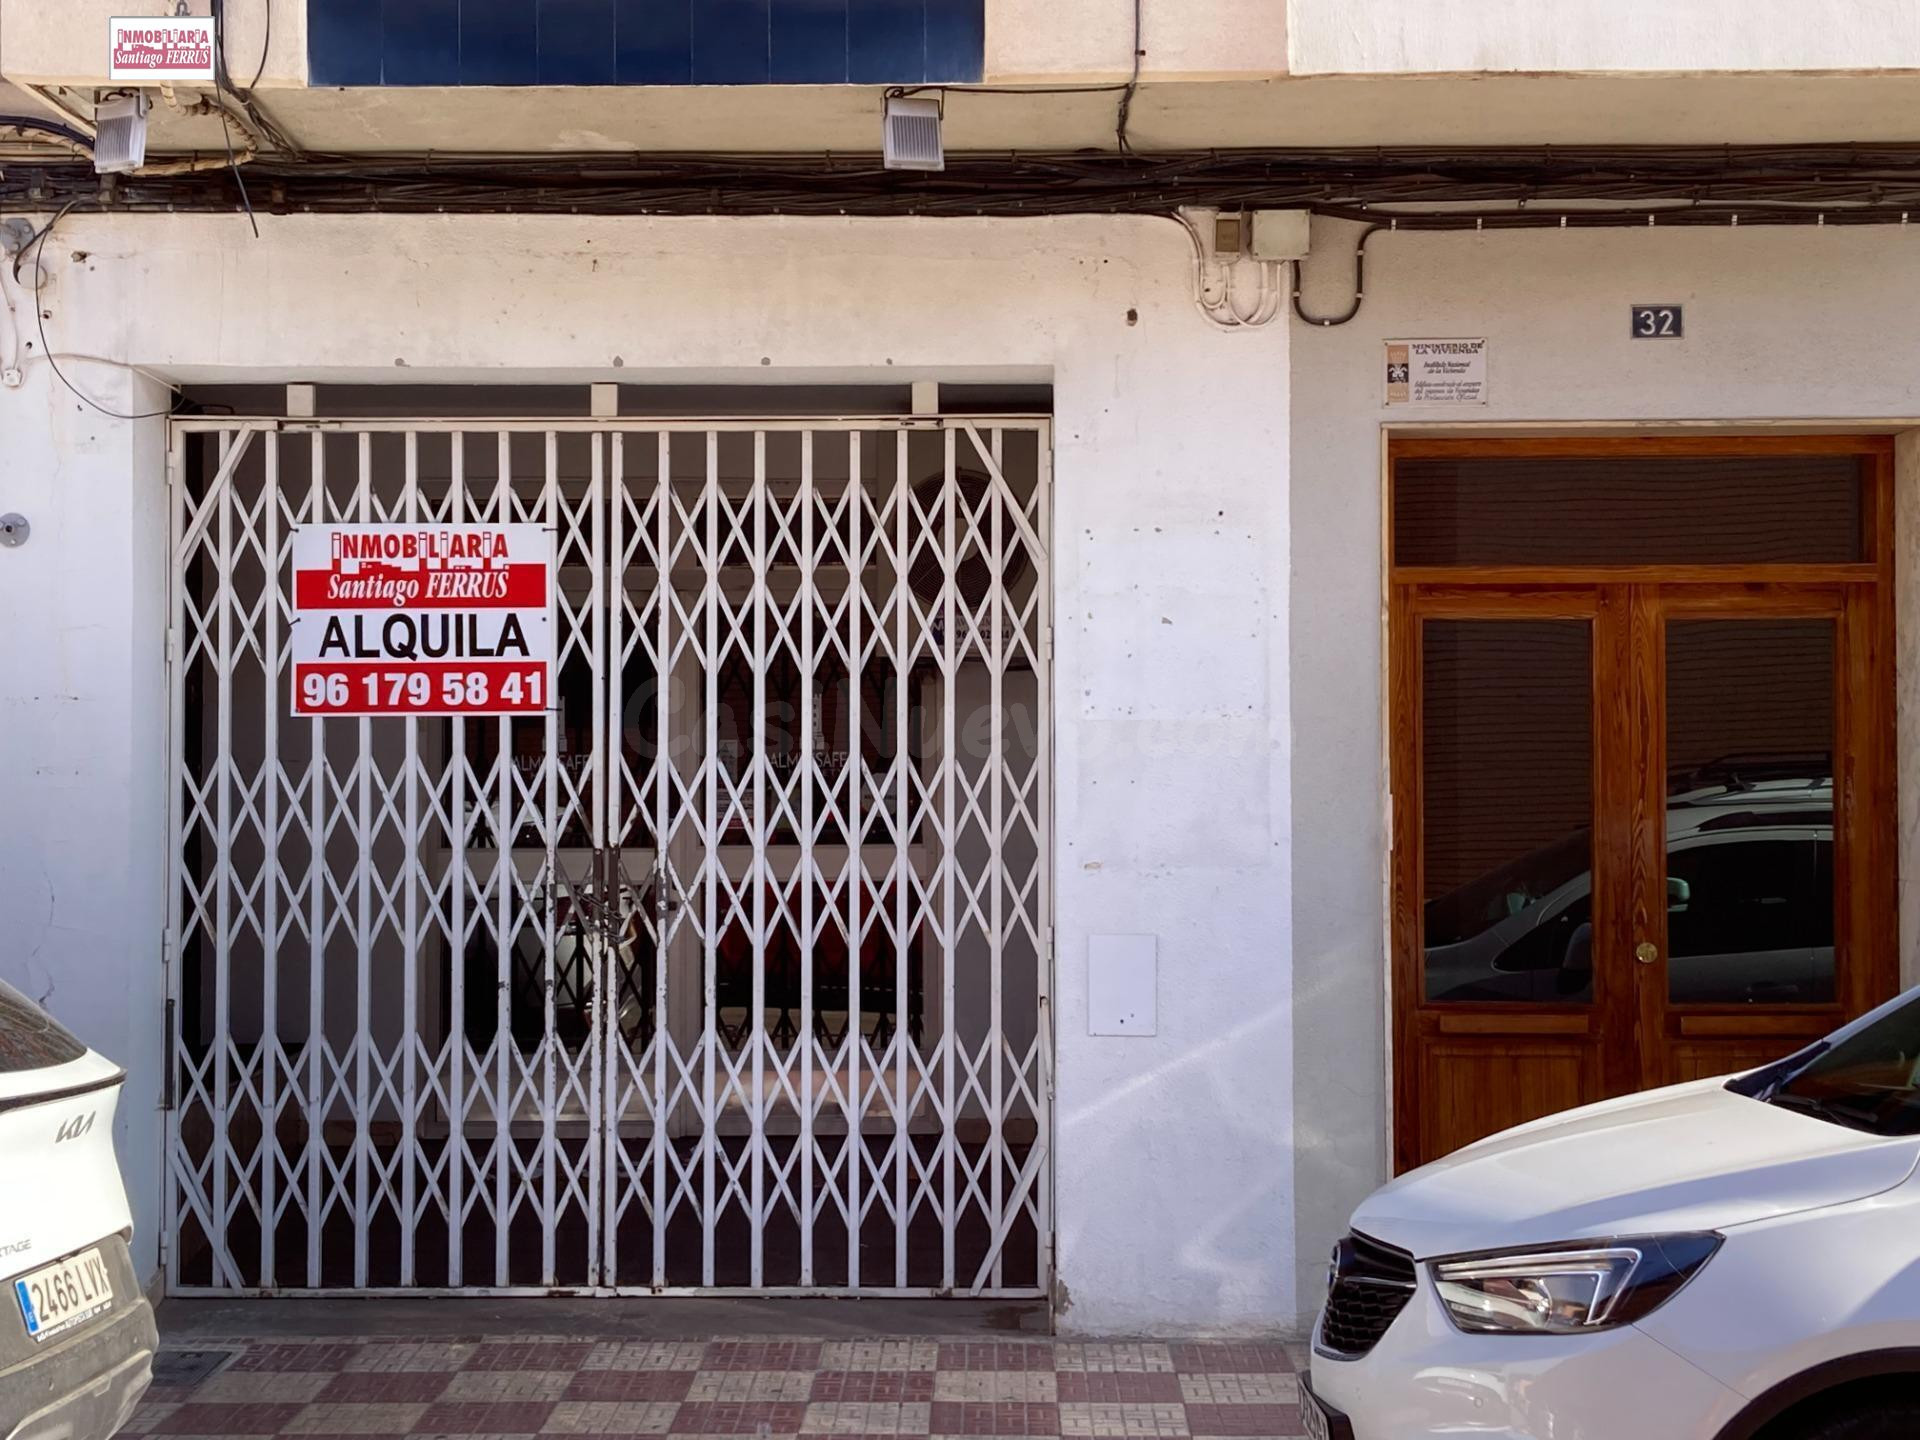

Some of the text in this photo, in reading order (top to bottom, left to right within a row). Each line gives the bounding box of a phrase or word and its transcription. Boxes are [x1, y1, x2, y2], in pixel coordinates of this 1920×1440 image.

[115, 49, 209, 68] Santiago FERRUS
[1640, 310, 1674, 335] 32
[327, 572, 510, 607] Santiago FERRUS
[318, 613, 530, 661] ALQUILA
[303, 671, 541, 707] 96 179 58 41
[0, 1239, 32, 1258] TAGE
[31, 1268, 79, 1322] 2466
[74, 1255, 109, 1302] LVX
